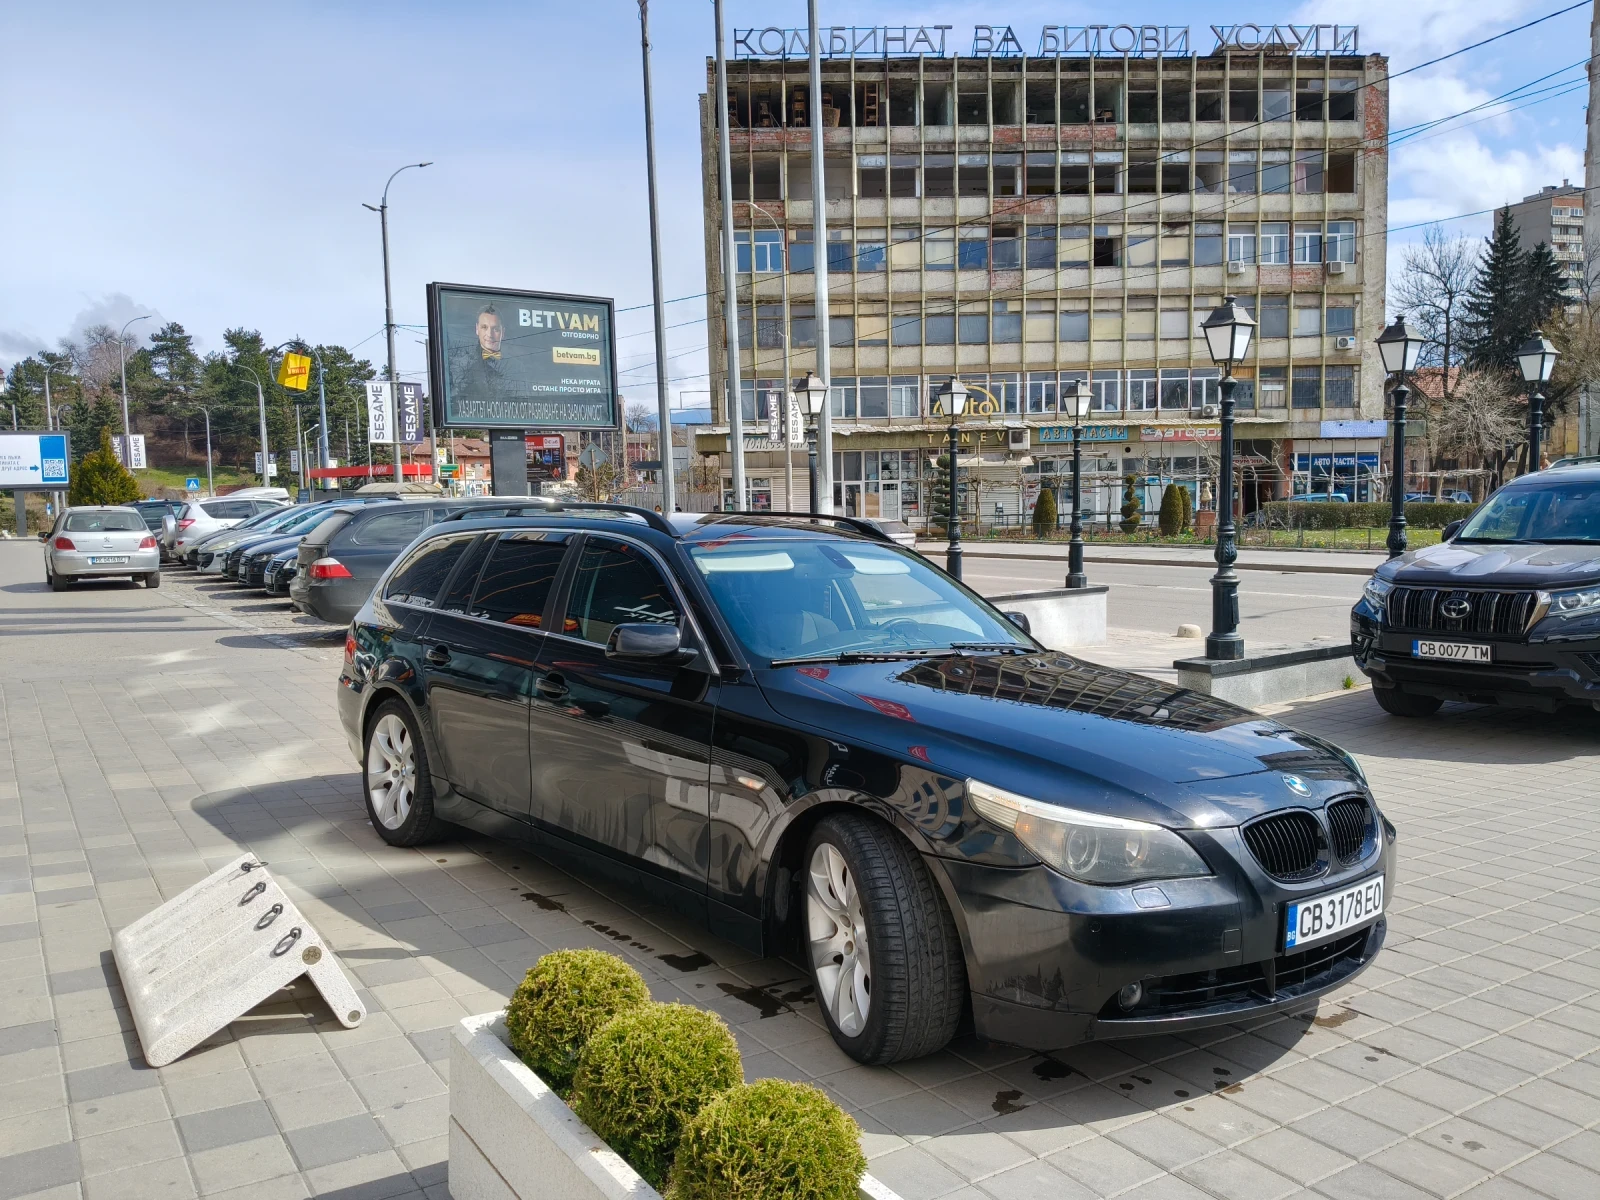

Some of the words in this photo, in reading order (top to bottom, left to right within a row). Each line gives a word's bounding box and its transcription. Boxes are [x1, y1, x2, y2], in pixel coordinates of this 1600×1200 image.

[1043, 23, 1190, 52] БИТОВИ
[1210, 22, 1360, 51] УСЛУГИ
[518, 308, 599, 332] BETVAM
[561, 331, 600, 340] ОТГОВОРНО
[556, 350, 597, 361] betvam.bg
[371, 384, 385, 440] SESAME
[403, 385, 417, 441] SESAME
[769, 393, 778, 441] SESAME
[790, 395, 799, 441] SESAME
[927, 431, 1006, 444] TANEV
[1042, 426, 1125, 440] АВТЧАСТИ
[133, 437, 141, 467] SESAME
[1313, 457, 1331, 465] АВТО
[1420, 642, 1436, 656] CB
[1438, 644, 1469, 658] 0077
[1472, 646, 1489, 660] TM
[1299, 902, 1323, 938] CB
[1325, 889, 1363, 930] 3178
[1364, 881, 1382, 916] EO
[1287, 931, 1296, 942] BG
